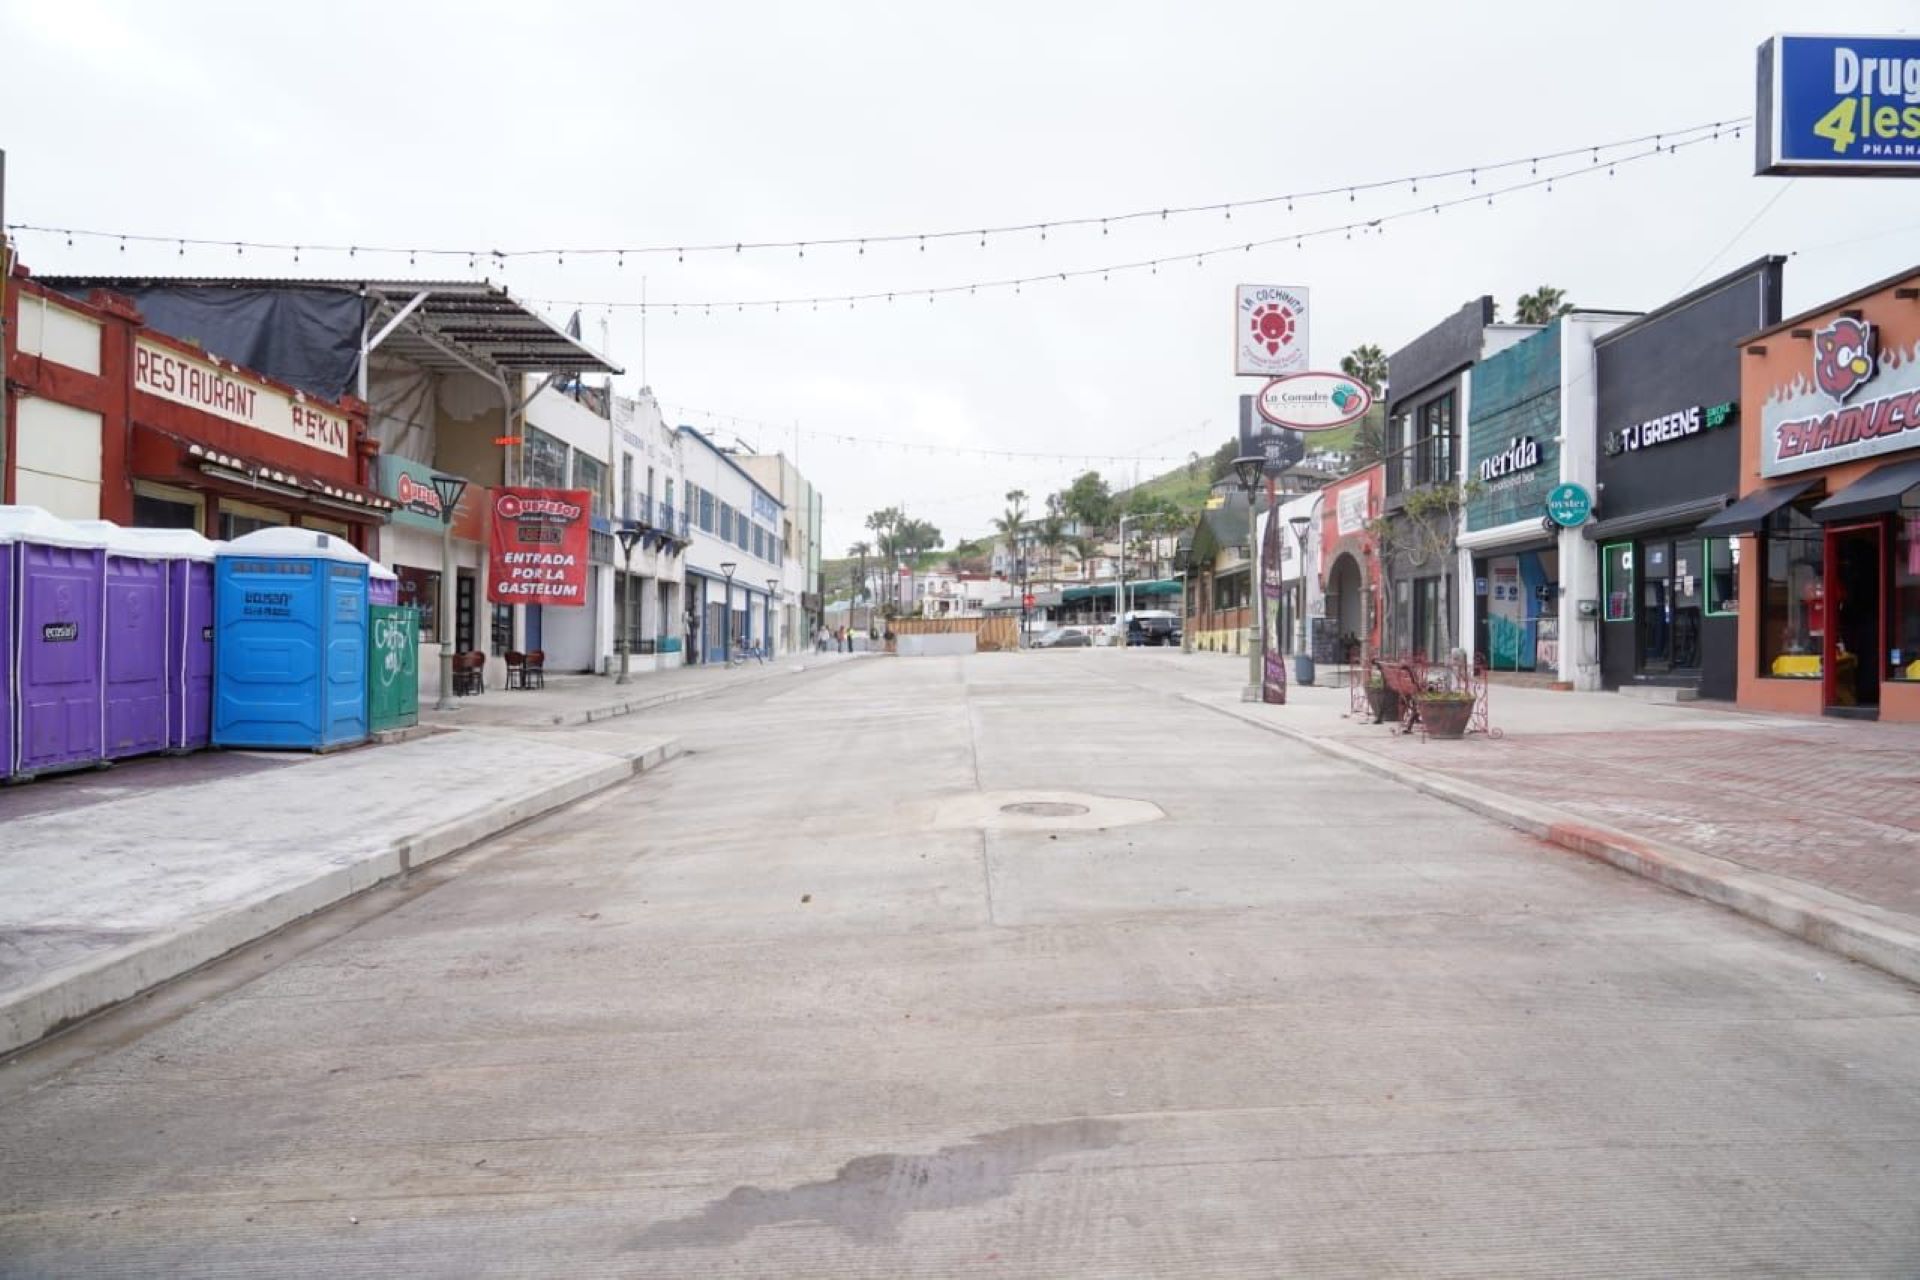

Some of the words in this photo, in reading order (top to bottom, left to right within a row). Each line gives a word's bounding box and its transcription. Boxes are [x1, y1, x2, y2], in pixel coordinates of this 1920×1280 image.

[1834, 47, 1920, 104] Drug
[136, 346, 257, 421] RESTAURANT
[292, 404, 344, 450] PEKIN
[1621, 424, 1640, 453] TJ
[1643, 406, 1700, 447] GREENS
[1481, 435, 1538, 480] nerida
[504, 551, 575, 566] ENTRADA
[512, 568, 543, 580] POR
[546, 569, 565, 580] LA
[498, 581, 577, 597] GASTELUM
